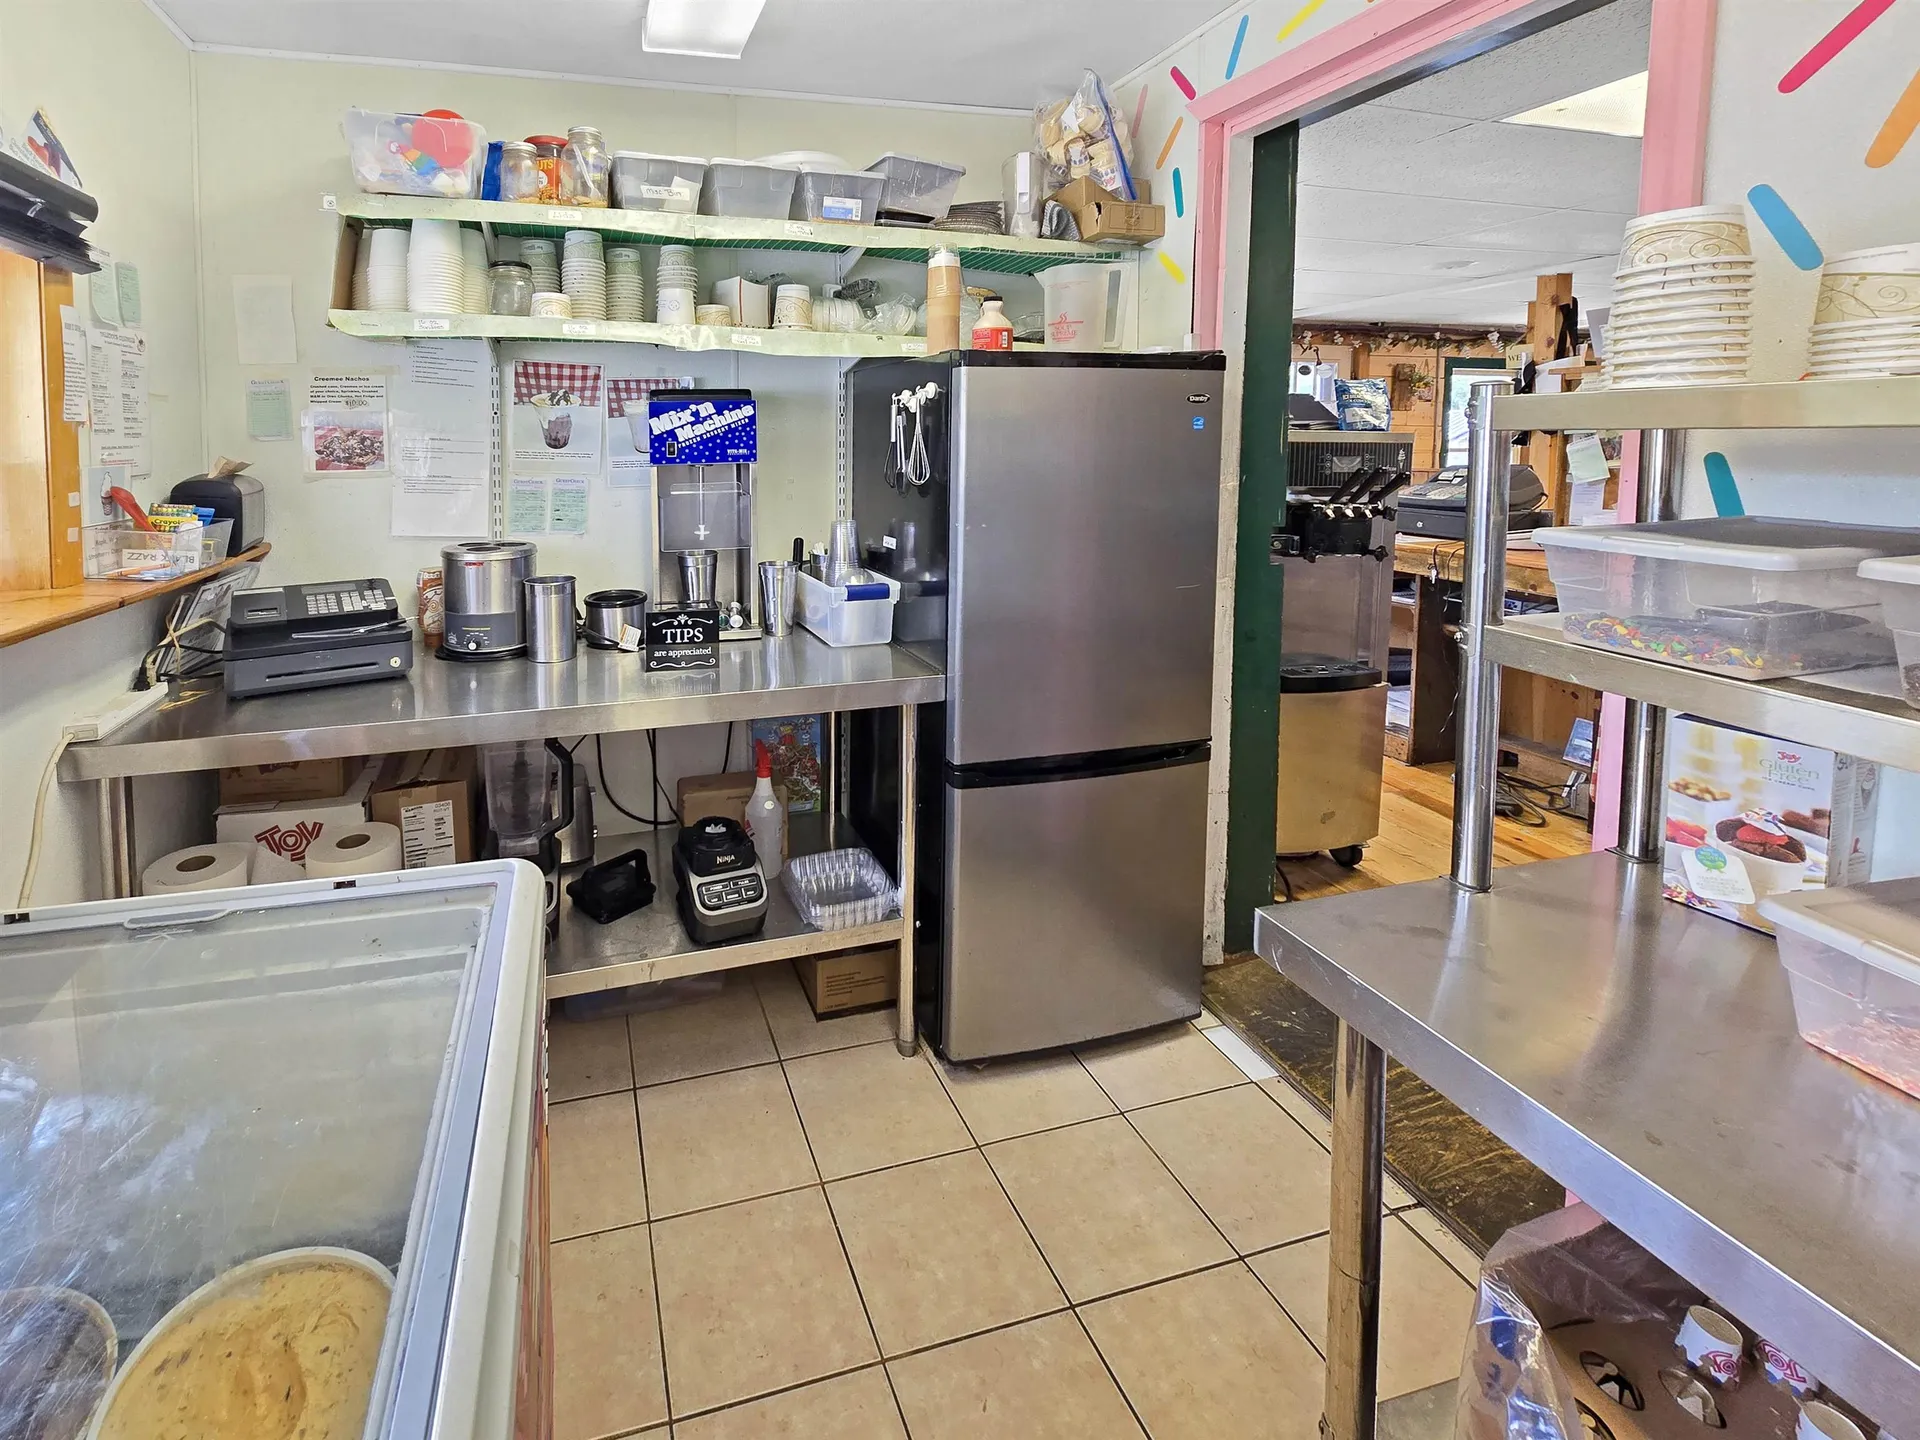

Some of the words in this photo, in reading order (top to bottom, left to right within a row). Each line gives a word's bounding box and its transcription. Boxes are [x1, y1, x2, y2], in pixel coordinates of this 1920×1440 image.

[649, 402, 716, 435] Mix'n
[674, 405, 755, 442] Machine
[678, 436, 701, 449] FROZEN
[703, 425, 729, 439] DESSERT
[730, 418, 749, 428] MIXER
[161, 554, 195, 564] BLAK
[662, 628, 704, 643] TIPS
[668, 647, 712, 658] appreciated
[1759, 758, 1820, 780] Gluten
[1768, 769, 1809, 784] Free
